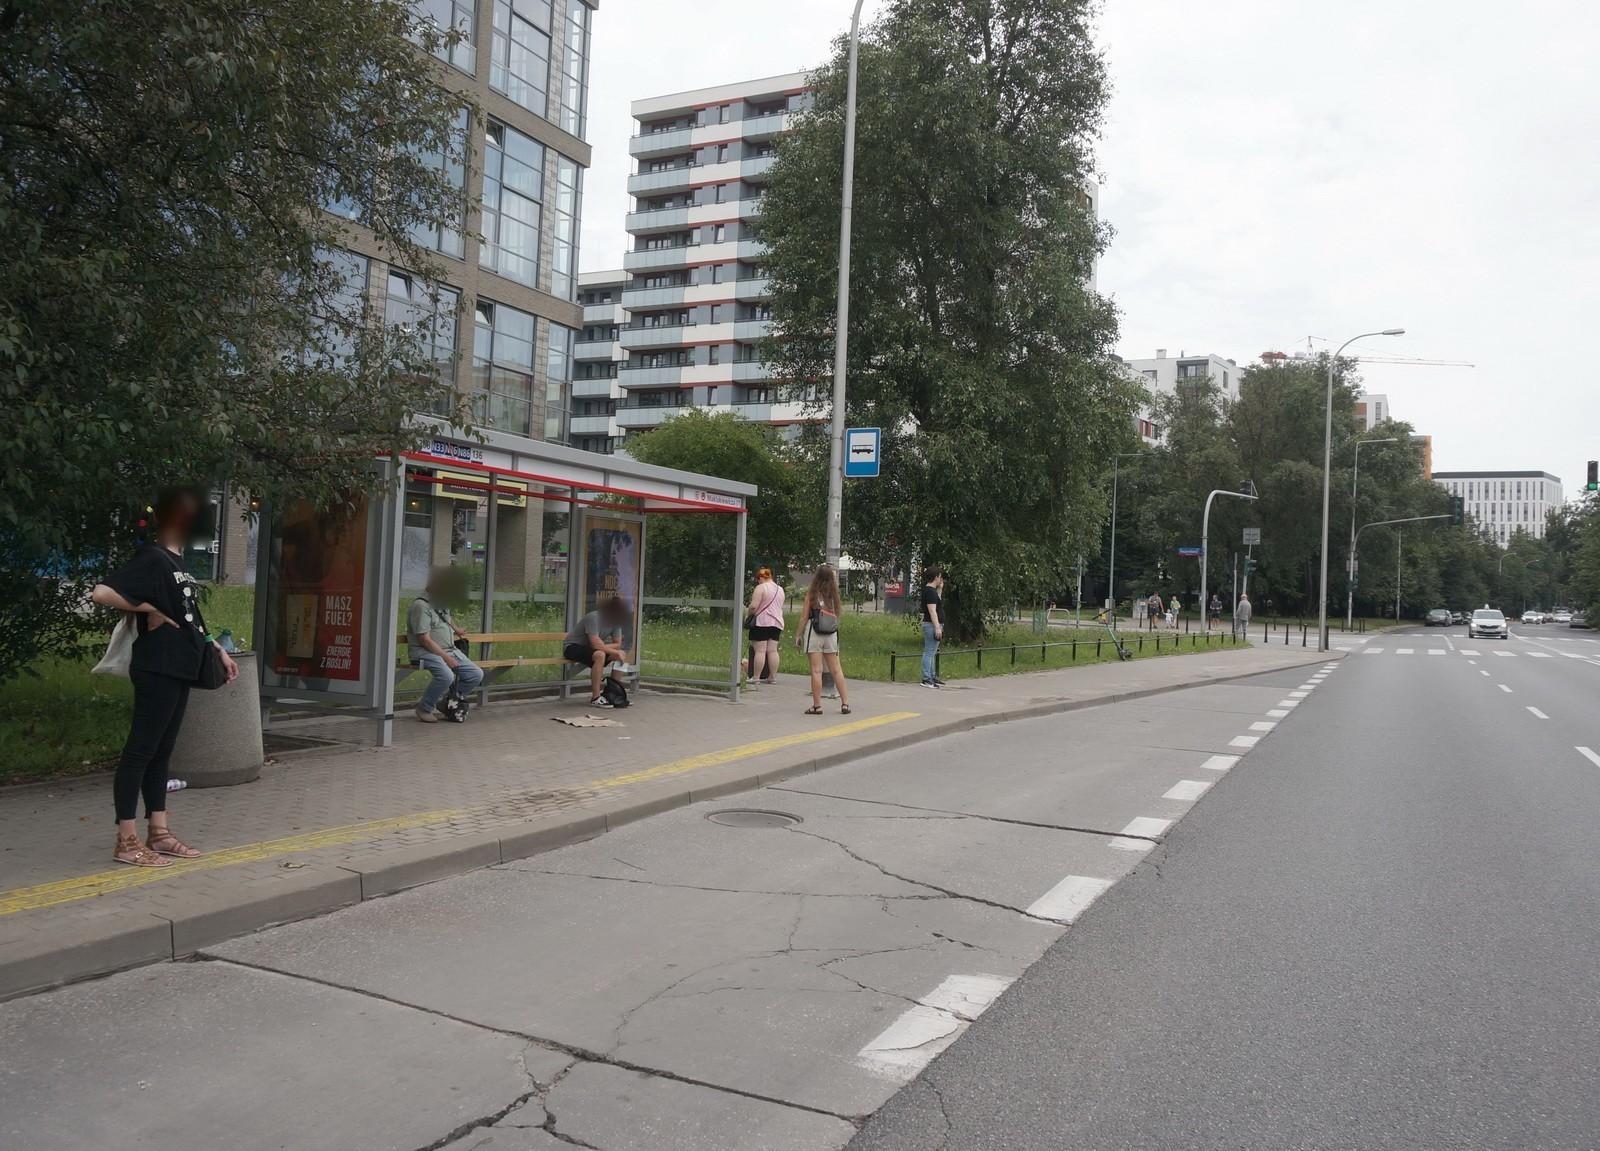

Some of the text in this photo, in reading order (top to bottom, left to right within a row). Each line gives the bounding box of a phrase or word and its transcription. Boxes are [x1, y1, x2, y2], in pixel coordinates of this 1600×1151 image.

[432, 441, 445, 453] N33
[472, 448, 483, 459] 136
[326, 595, 352, 610] MASZ
[325, 610, 352, 626] FUEL?
[335, 634, 352, 645] MASZ
